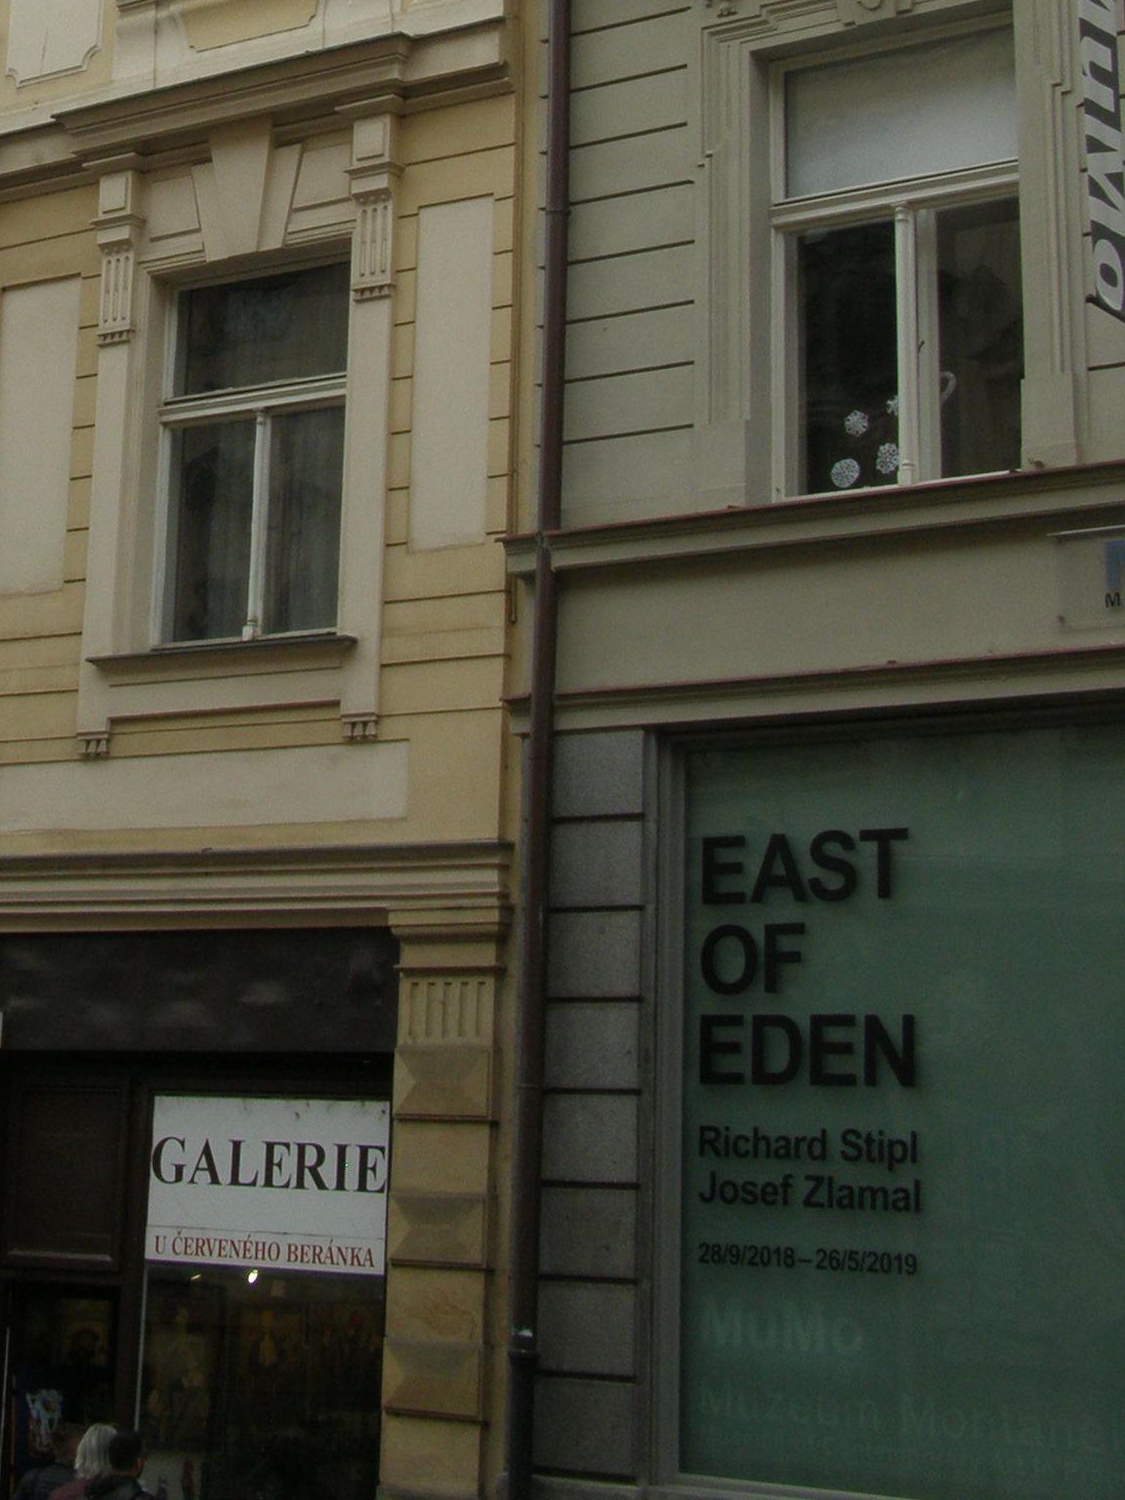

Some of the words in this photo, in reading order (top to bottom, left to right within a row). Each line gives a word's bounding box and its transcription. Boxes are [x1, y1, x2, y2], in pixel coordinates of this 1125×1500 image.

[702, 828, 908, 904] EAST
[701, 922, 806, 995] OF
[700, 1014, 916, 1088] EDEN
[152, 1136, 387, 1193] GALERIE
[699, 1125, 827, 1161] Richard
[840, 1128, 918, 1172] Stipl
[699, 1170, 793, 1206] Josef
[803, 1174, 922, 1213] Zlamal
[155, 1235, 167, 1254] U
[171, 1231, 280, 1262] ČERVENÉHO
[286, 1239, 375, 1268] BERÁNKA
